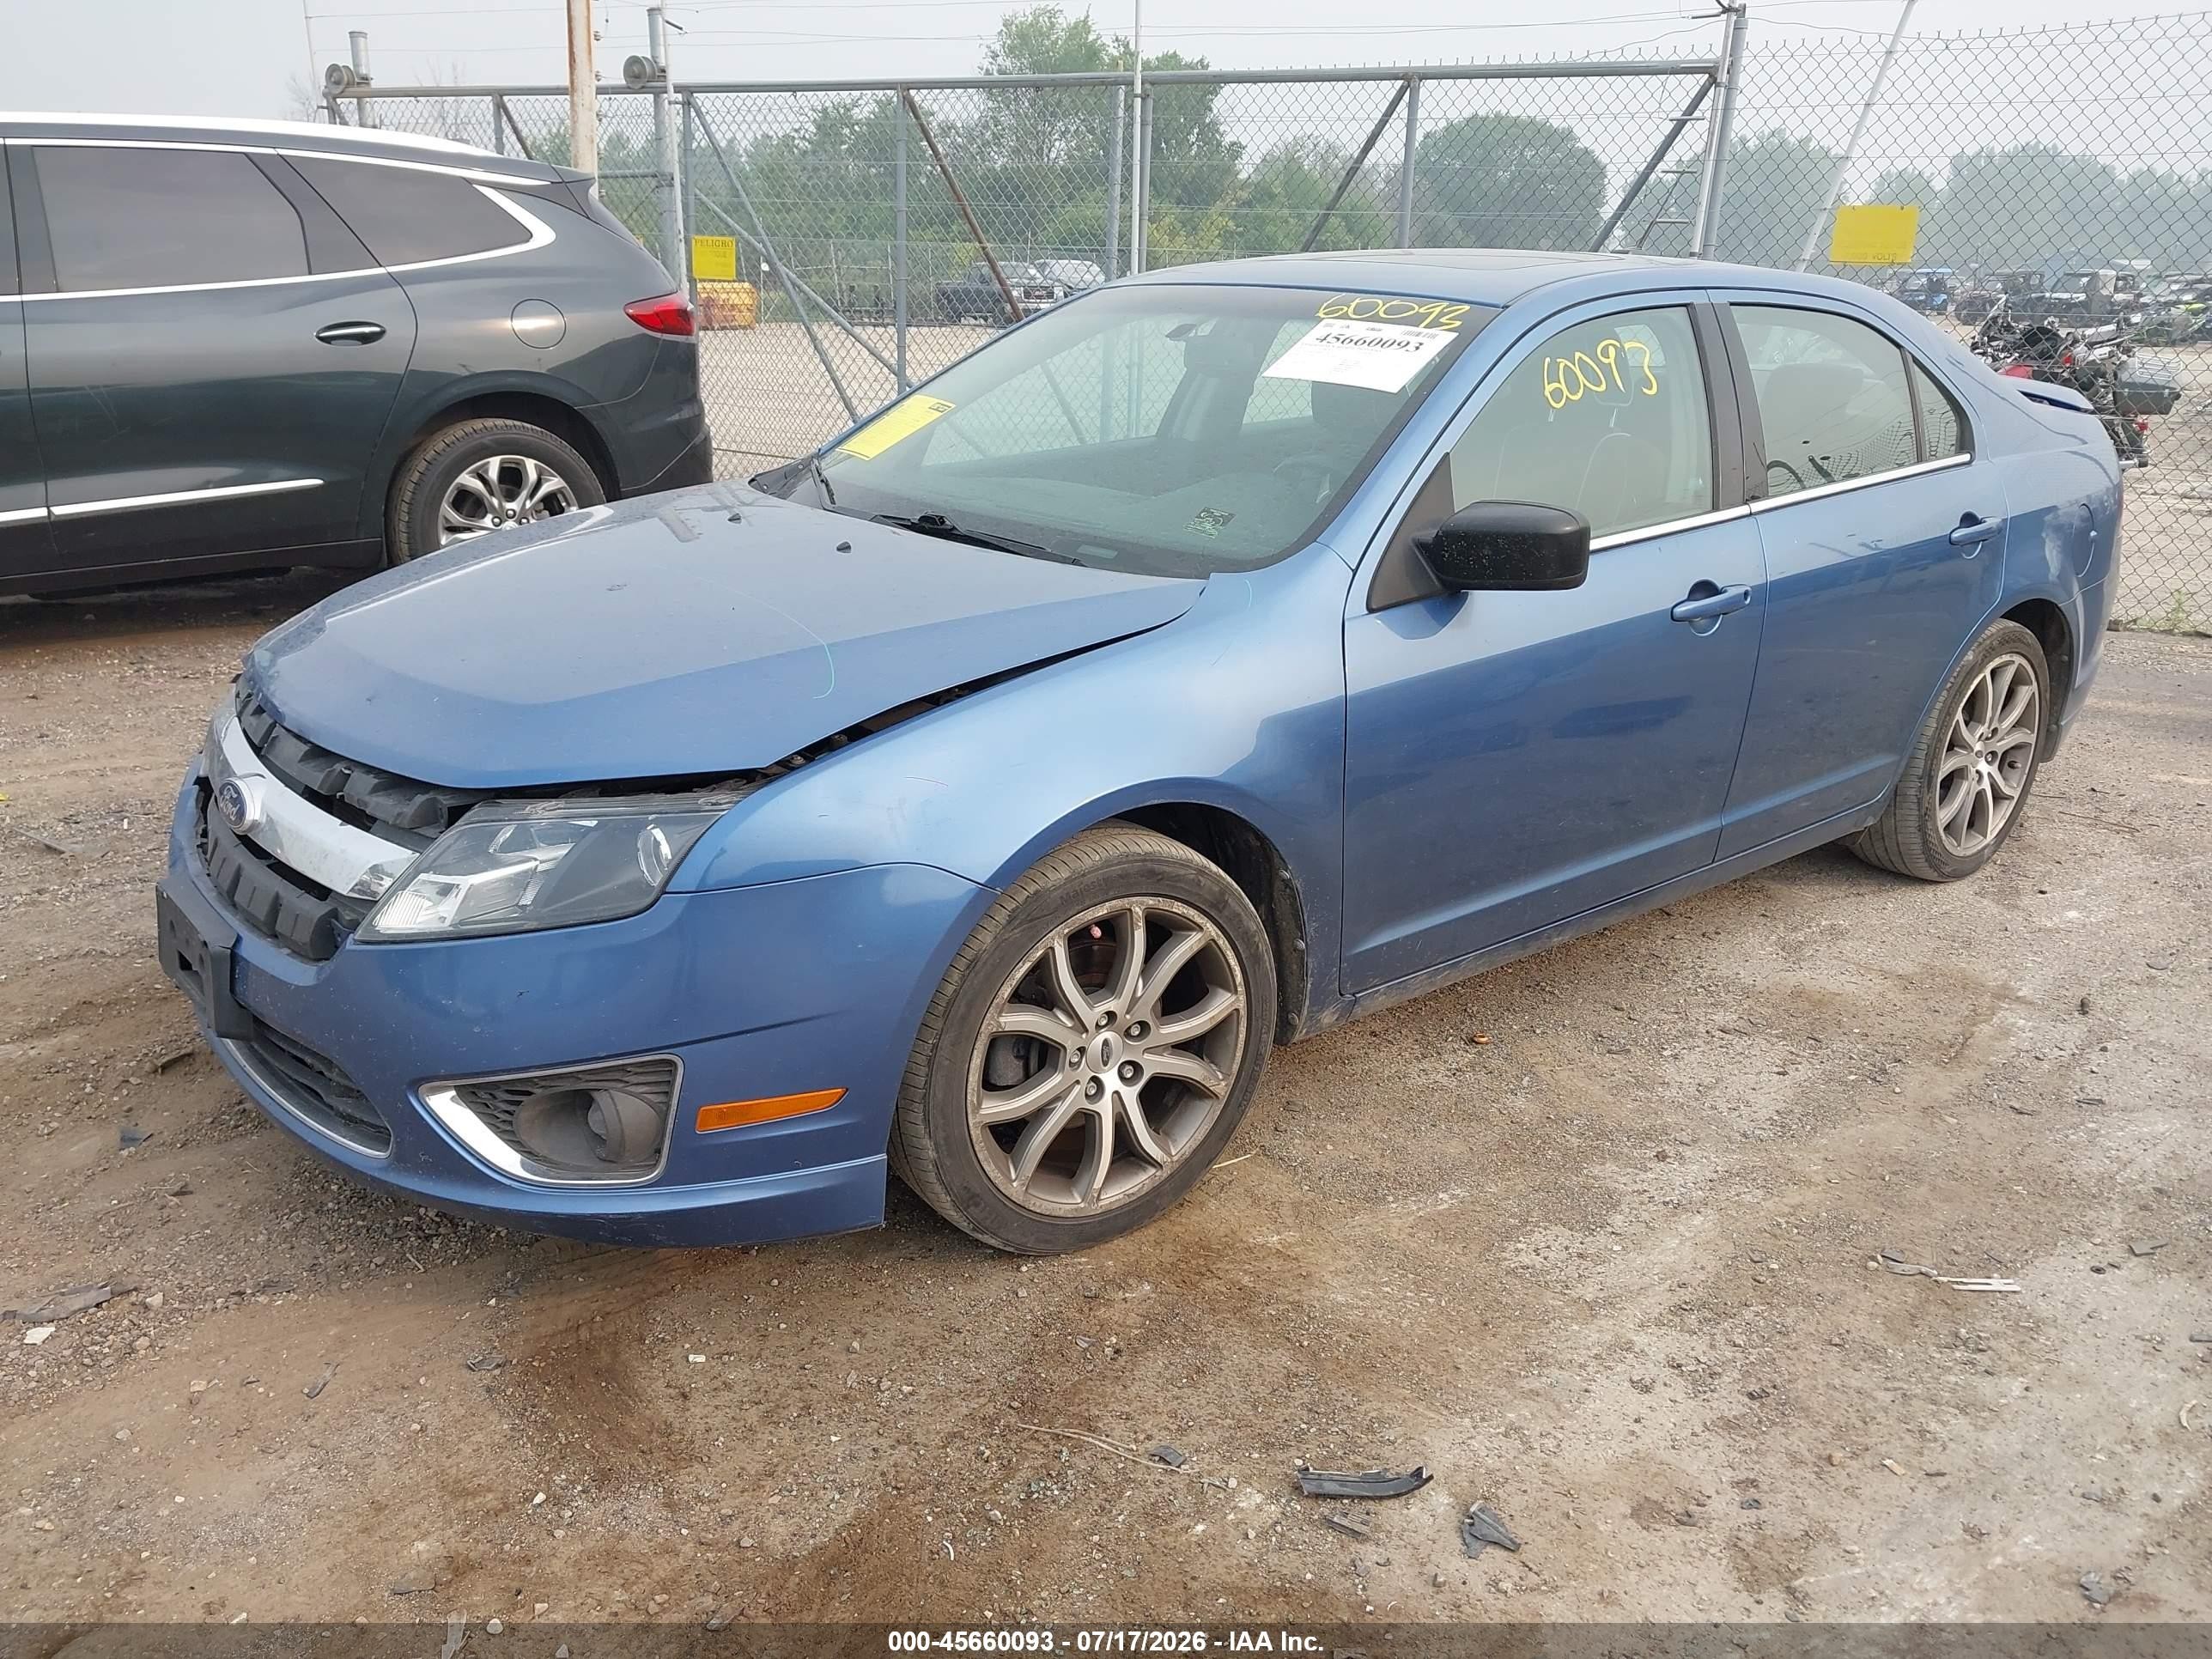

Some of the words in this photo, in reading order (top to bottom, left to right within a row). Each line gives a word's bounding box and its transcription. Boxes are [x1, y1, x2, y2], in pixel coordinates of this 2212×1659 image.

[694, 239, 733, 248] PELIGRO
[1315, 293, 1471, 331] 60093
[1316, 331, 1424, 353] 45660093
[1544, 339, 1658, 409] 60093
